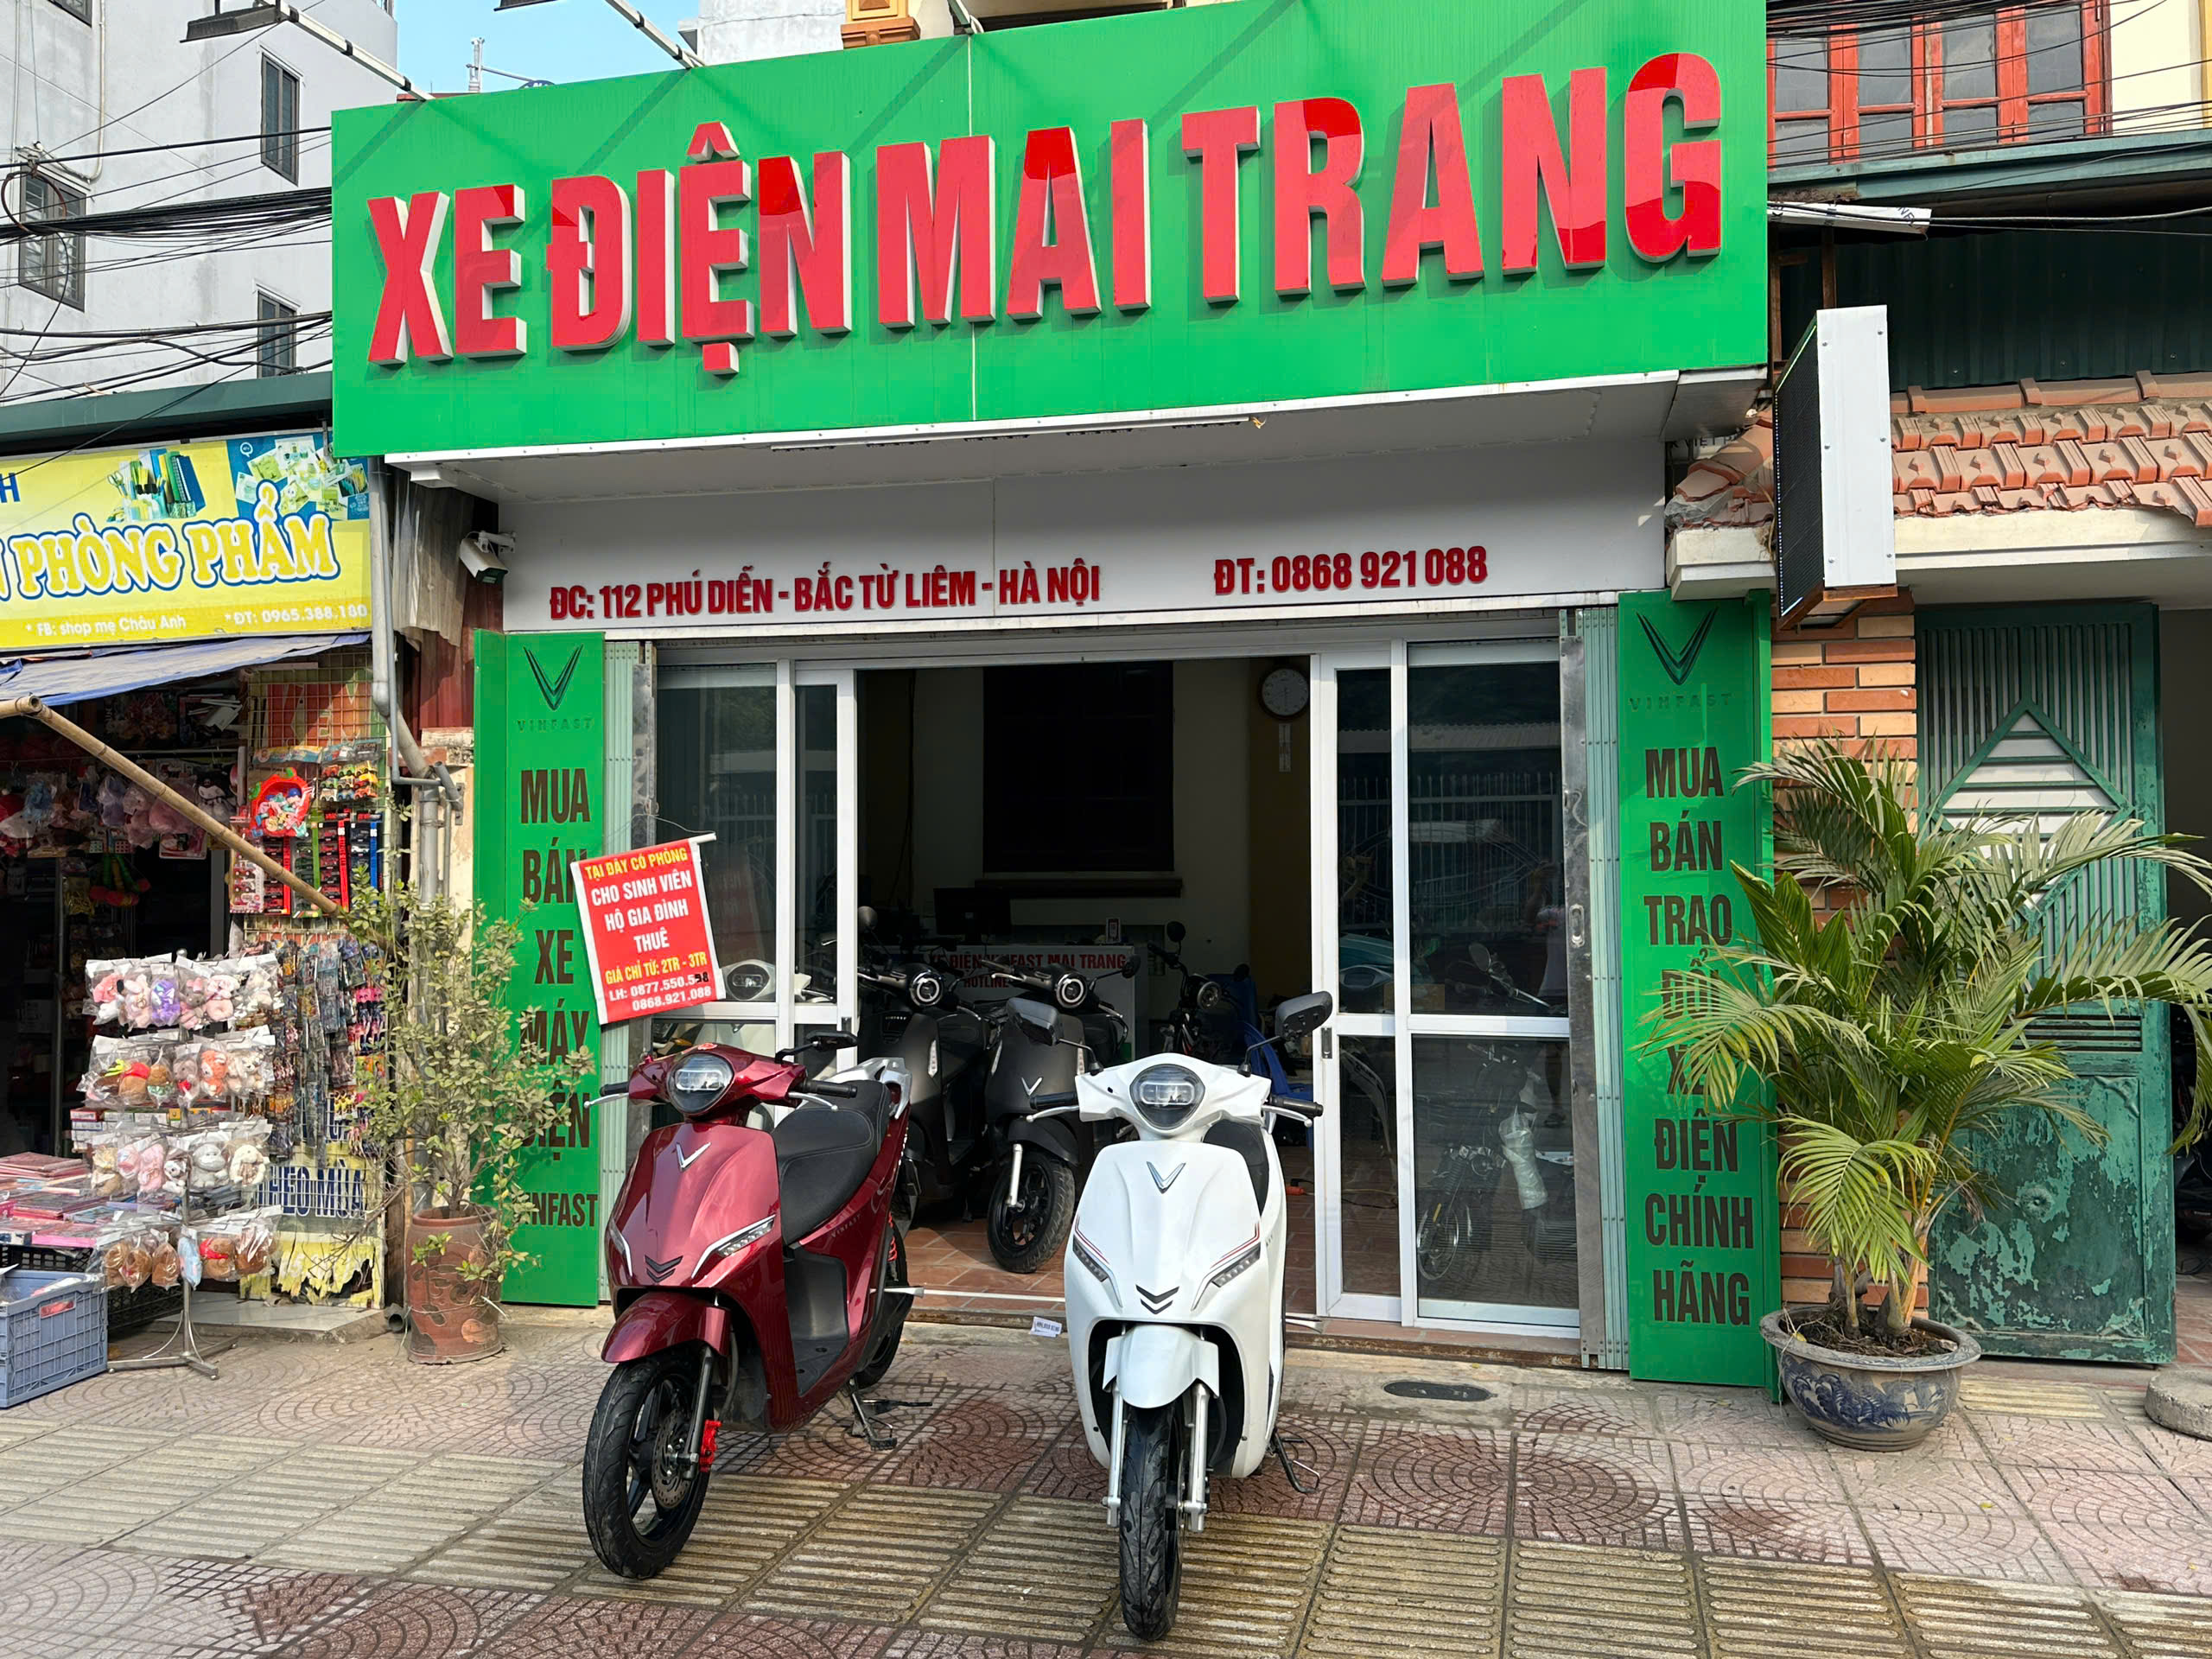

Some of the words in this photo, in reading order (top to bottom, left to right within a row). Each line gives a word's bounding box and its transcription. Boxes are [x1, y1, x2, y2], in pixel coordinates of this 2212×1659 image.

[368, 184, 526, 365] XE
[546, 121, 852, 375] ĐIỆN
[877, 118, 1151, 329] MAI
[1181, 52, 1722, 304] TRANG
[9, 512, 185, 601] PHÒNG
[182, 479, 340, 588] PHẨM
[550, 586, 594, 620] ĐC:
[599, 584, 642, 619] 112
[647, 569, 702, 617] PHÚ
[708, 565, 773, 614] DIỄN
[794, 562, 854, 612] BẮC
[859, 563, 899, 610] TỪ
[906, 564, 976, 608] LIÊM
[999, 561, 1041, 605] HÀ
[1047, 557, 1100, 607] NỘI
[1214, 558, 1265, 595] ĐT:
[1271, 552, 1352, 593] 0868
[1360, 550, 1416, 589] 921
[1425, 545, 1488, 586] 088
[60, 621, 92, 637] shop
[95, 621, 116, 636] mẹ
[118, 615, 156, 631] Châu
[160, 614, 186, 630] Anh
[234, 612, 257, 625] ĐT:
[1630, 692, 1731, 710] VINFAST
[517, 718, 592, 732] VINFAST
[1645, 747, 1724, 798] MUA
[521, 768, 591, 824] MUA
[1649, 810, 1723, 872] BÁN
[584, 864, 604, 881] TẠI
[606, 858, 627, 876] ĐÂY
[630, 853, 646, 870] CÓ
[648, 848, 688, 867] PHÒNG
[591, 884, 620, 906] CHO
[622, 877, 658, 900] SINH
[659, 868, 692, 893] VIÊN
[604, 907, 625, 933] HỘ
[626, 906, 652, 927] GIA
[653, 899, 689, 921] ĐÌNH
[1643, 893, 1732, 946] TRAO
[535, 930, 574, 984] XE
[633, 926, 671, 954] THUÊ
[1079, 953, 1127, 969] TRANG
[605, 966, 624, 985] GIÁ
[643, 958, 660, 977] TỪ:
[661, 957, 681, 974] 2TR
[688, 951, 708, 969] 3TR
[963, 974, 1009, 988] HOTLINE
[608, 988, 628, 1001] LH:
[632, 986, 712, 1011] 0868.921.088
[1654, 1108, 1738, 1183] ĐIỆN
[316, 1158, 365, 1219] MÙA
[1645, 1184, 1754, 1249] CHÍNH
[1653, 1259, 1750, 1325] HÃNG
